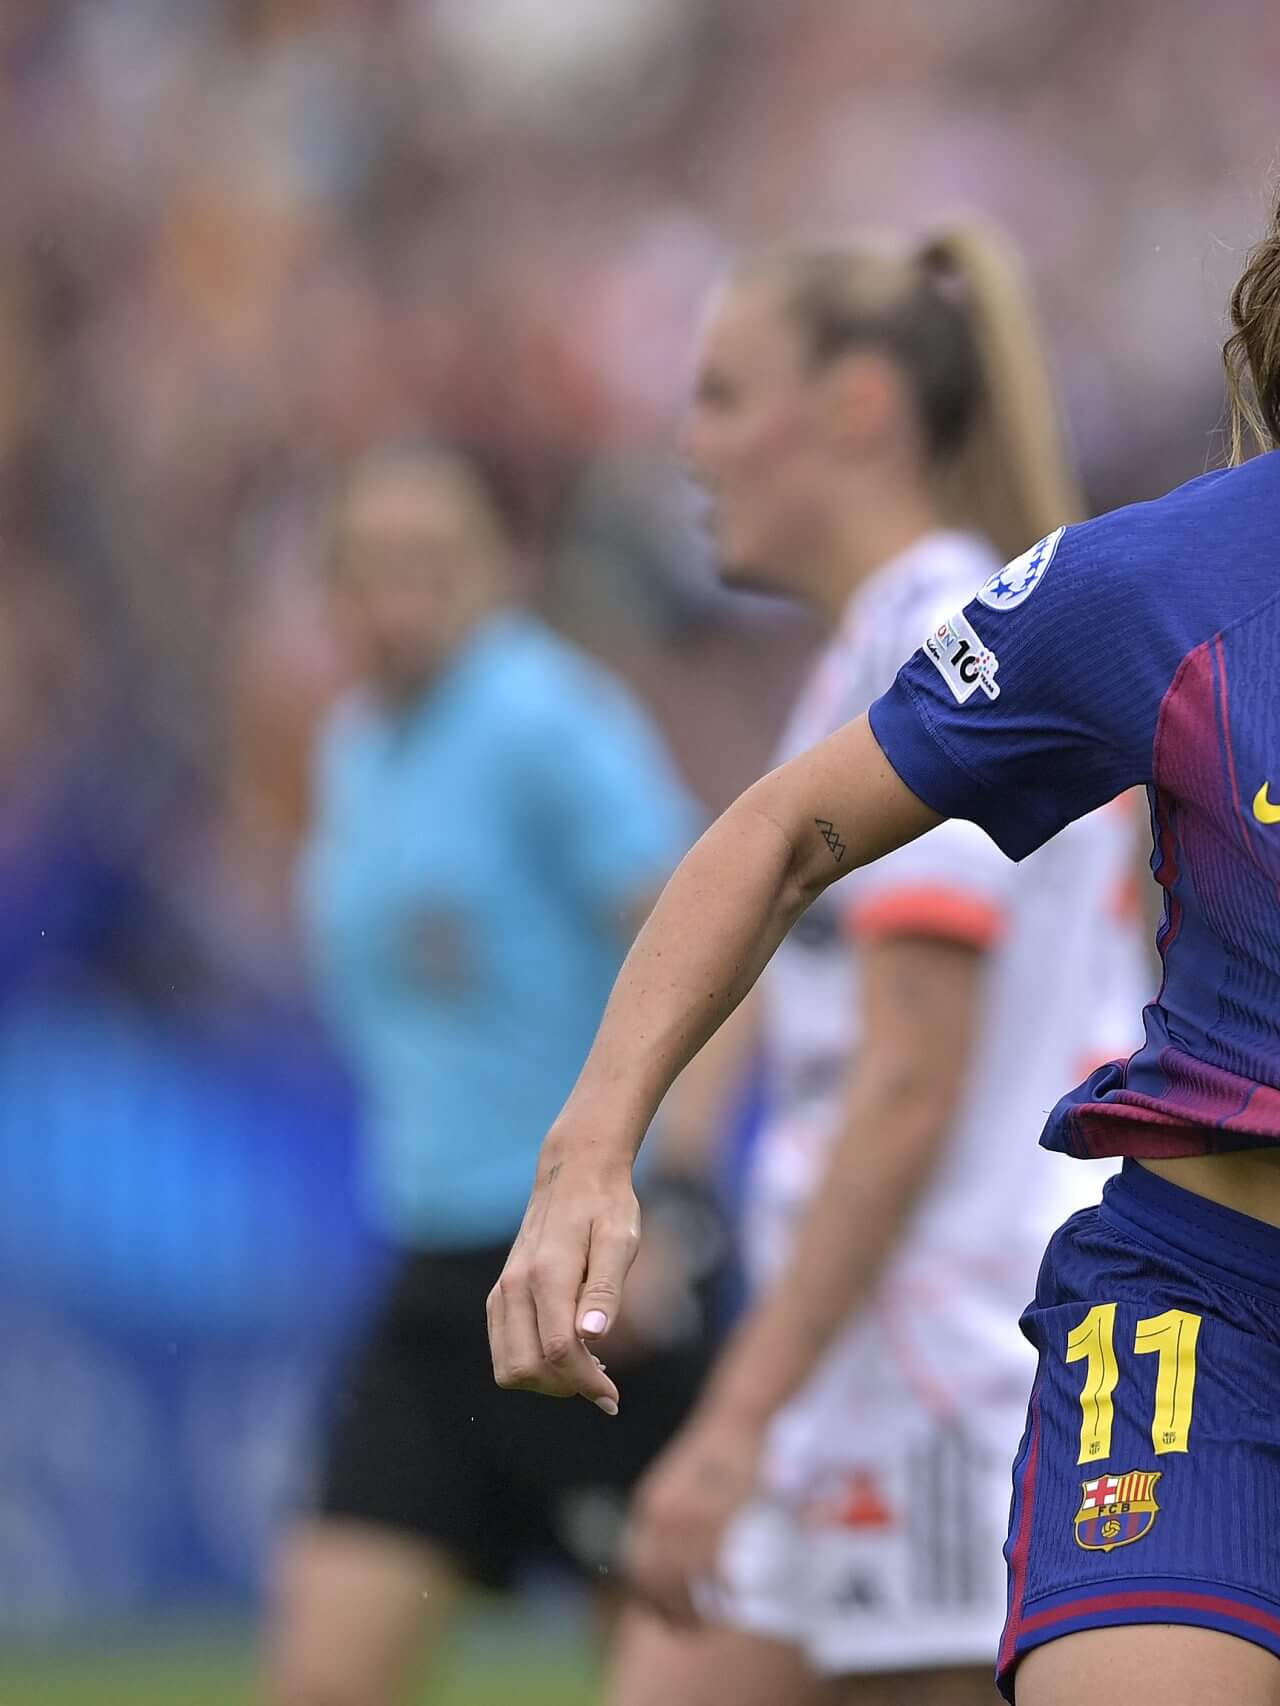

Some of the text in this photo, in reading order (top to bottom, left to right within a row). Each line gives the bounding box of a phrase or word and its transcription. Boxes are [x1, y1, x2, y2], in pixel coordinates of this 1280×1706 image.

[950, 639, 980, 684] 10
[1065, 1302, 1202, 1466] 11
[1097, 1502, 1131, 1517] FCB
